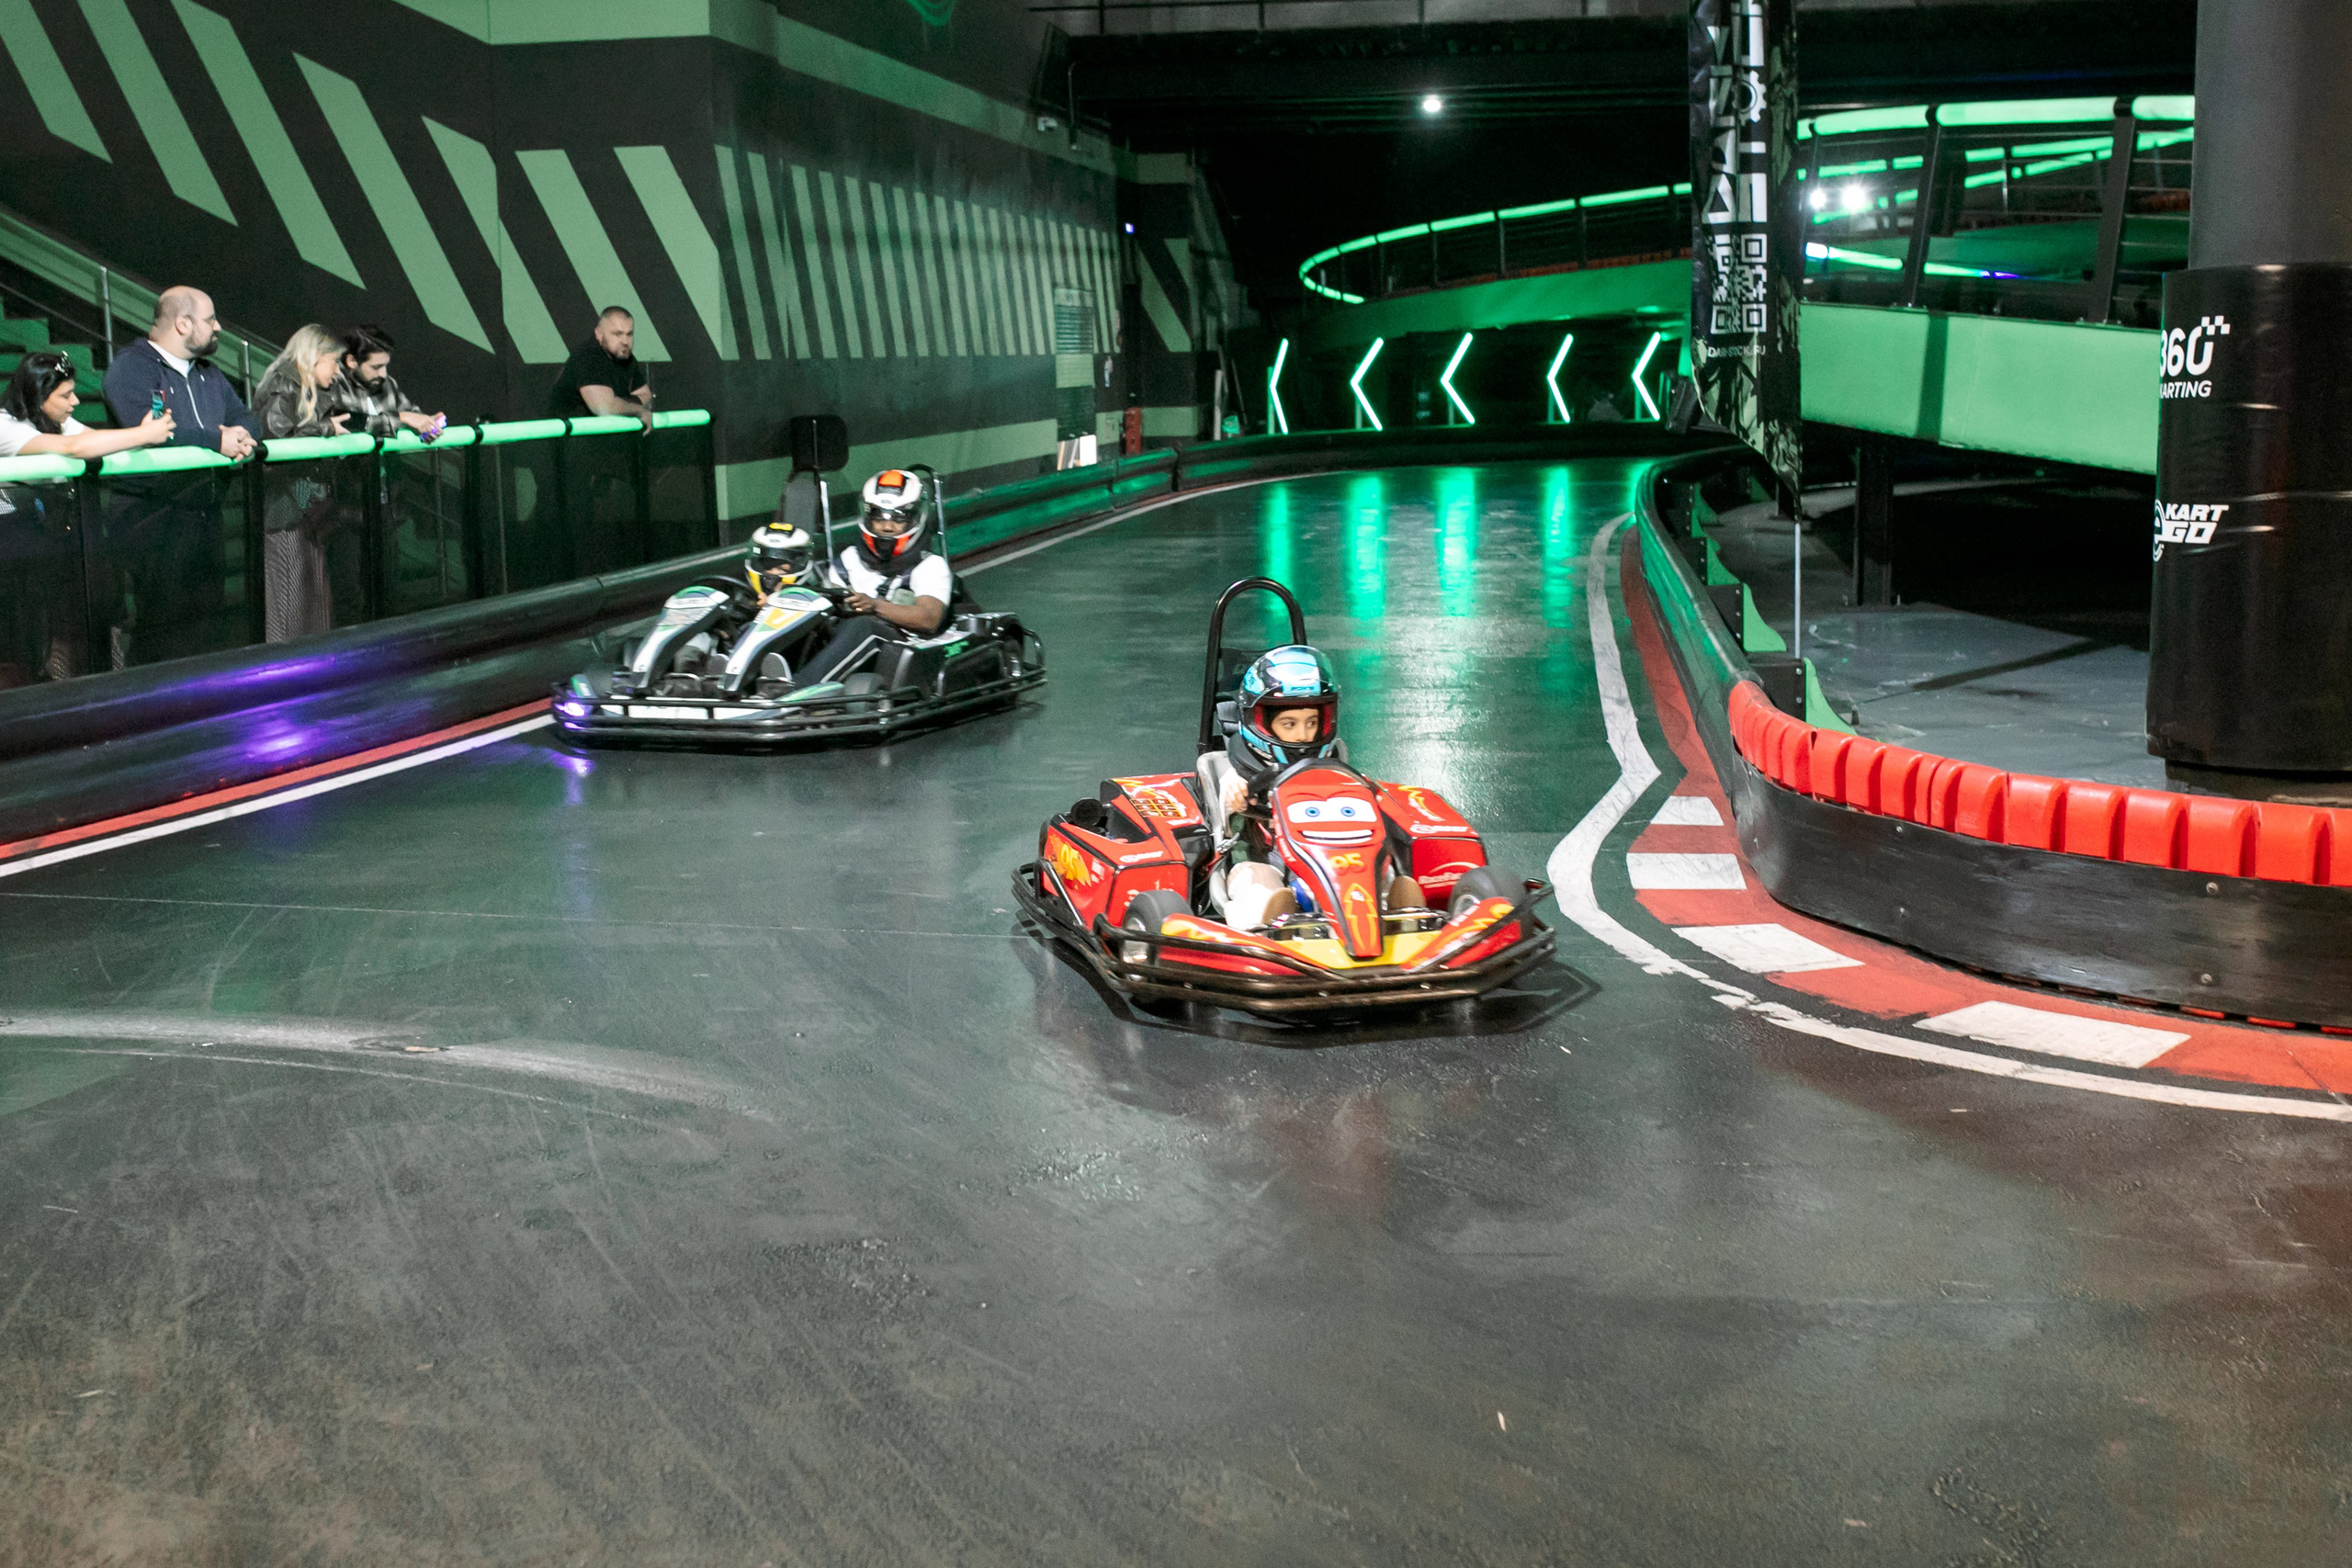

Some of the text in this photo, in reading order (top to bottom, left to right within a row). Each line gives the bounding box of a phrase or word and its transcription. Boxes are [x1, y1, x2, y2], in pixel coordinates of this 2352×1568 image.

[2165, 503, 2230, 522] KART
[2162, 521, 2218, 544] GO
[1330, 852, 1364, 869] 95
